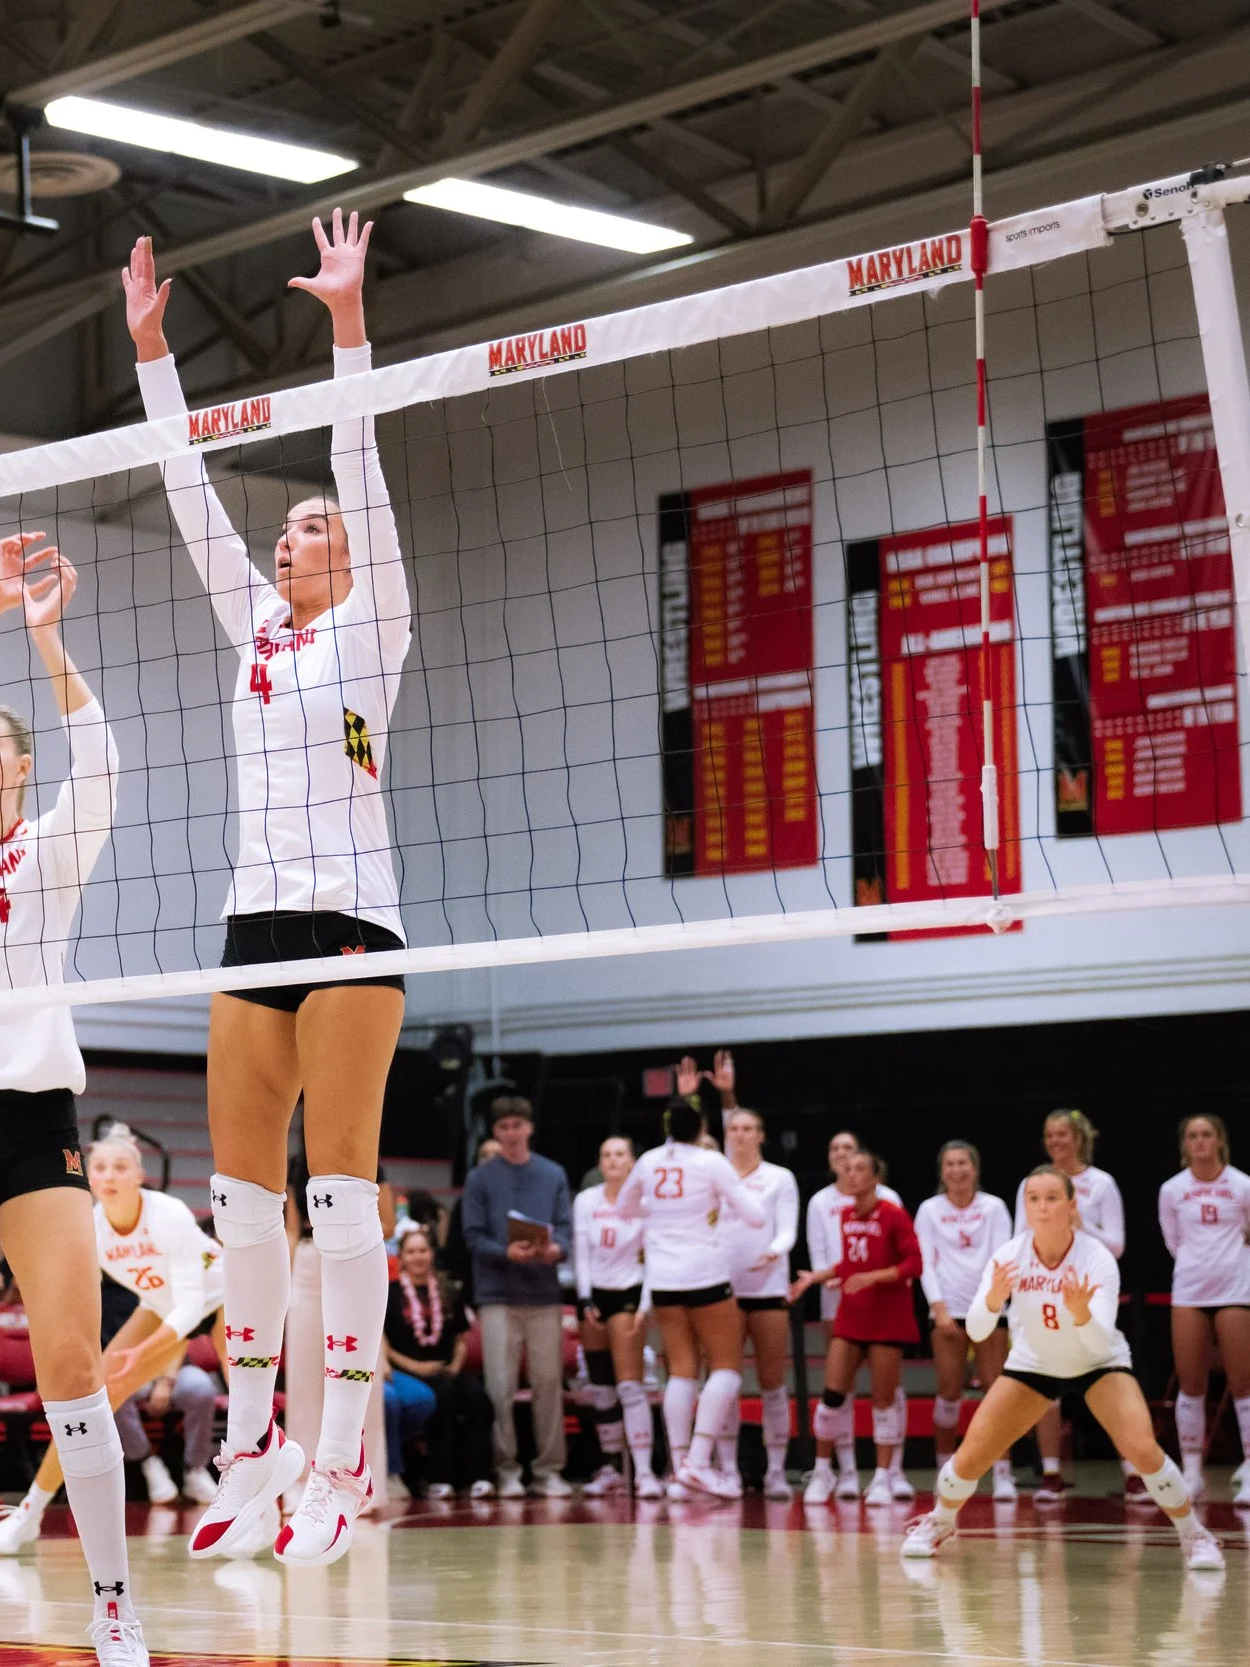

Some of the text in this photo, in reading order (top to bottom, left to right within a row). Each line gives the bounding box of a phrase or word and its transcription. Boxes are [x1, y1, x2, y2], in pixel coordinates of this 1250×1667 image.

[1005, 220, 1061, 243] sports imports
[846, 234, 963, 290] MARYLAND
[488, 323, 588, 370] MARYLAND
[188, 396, 271, 440] MARYLAND
[250, 664, 272, 704] 4
[654, 1168, 684, 1199] 23
[847, 1236, 869, 1262] 24
[1042, 1303, 1059, 1331] 8
